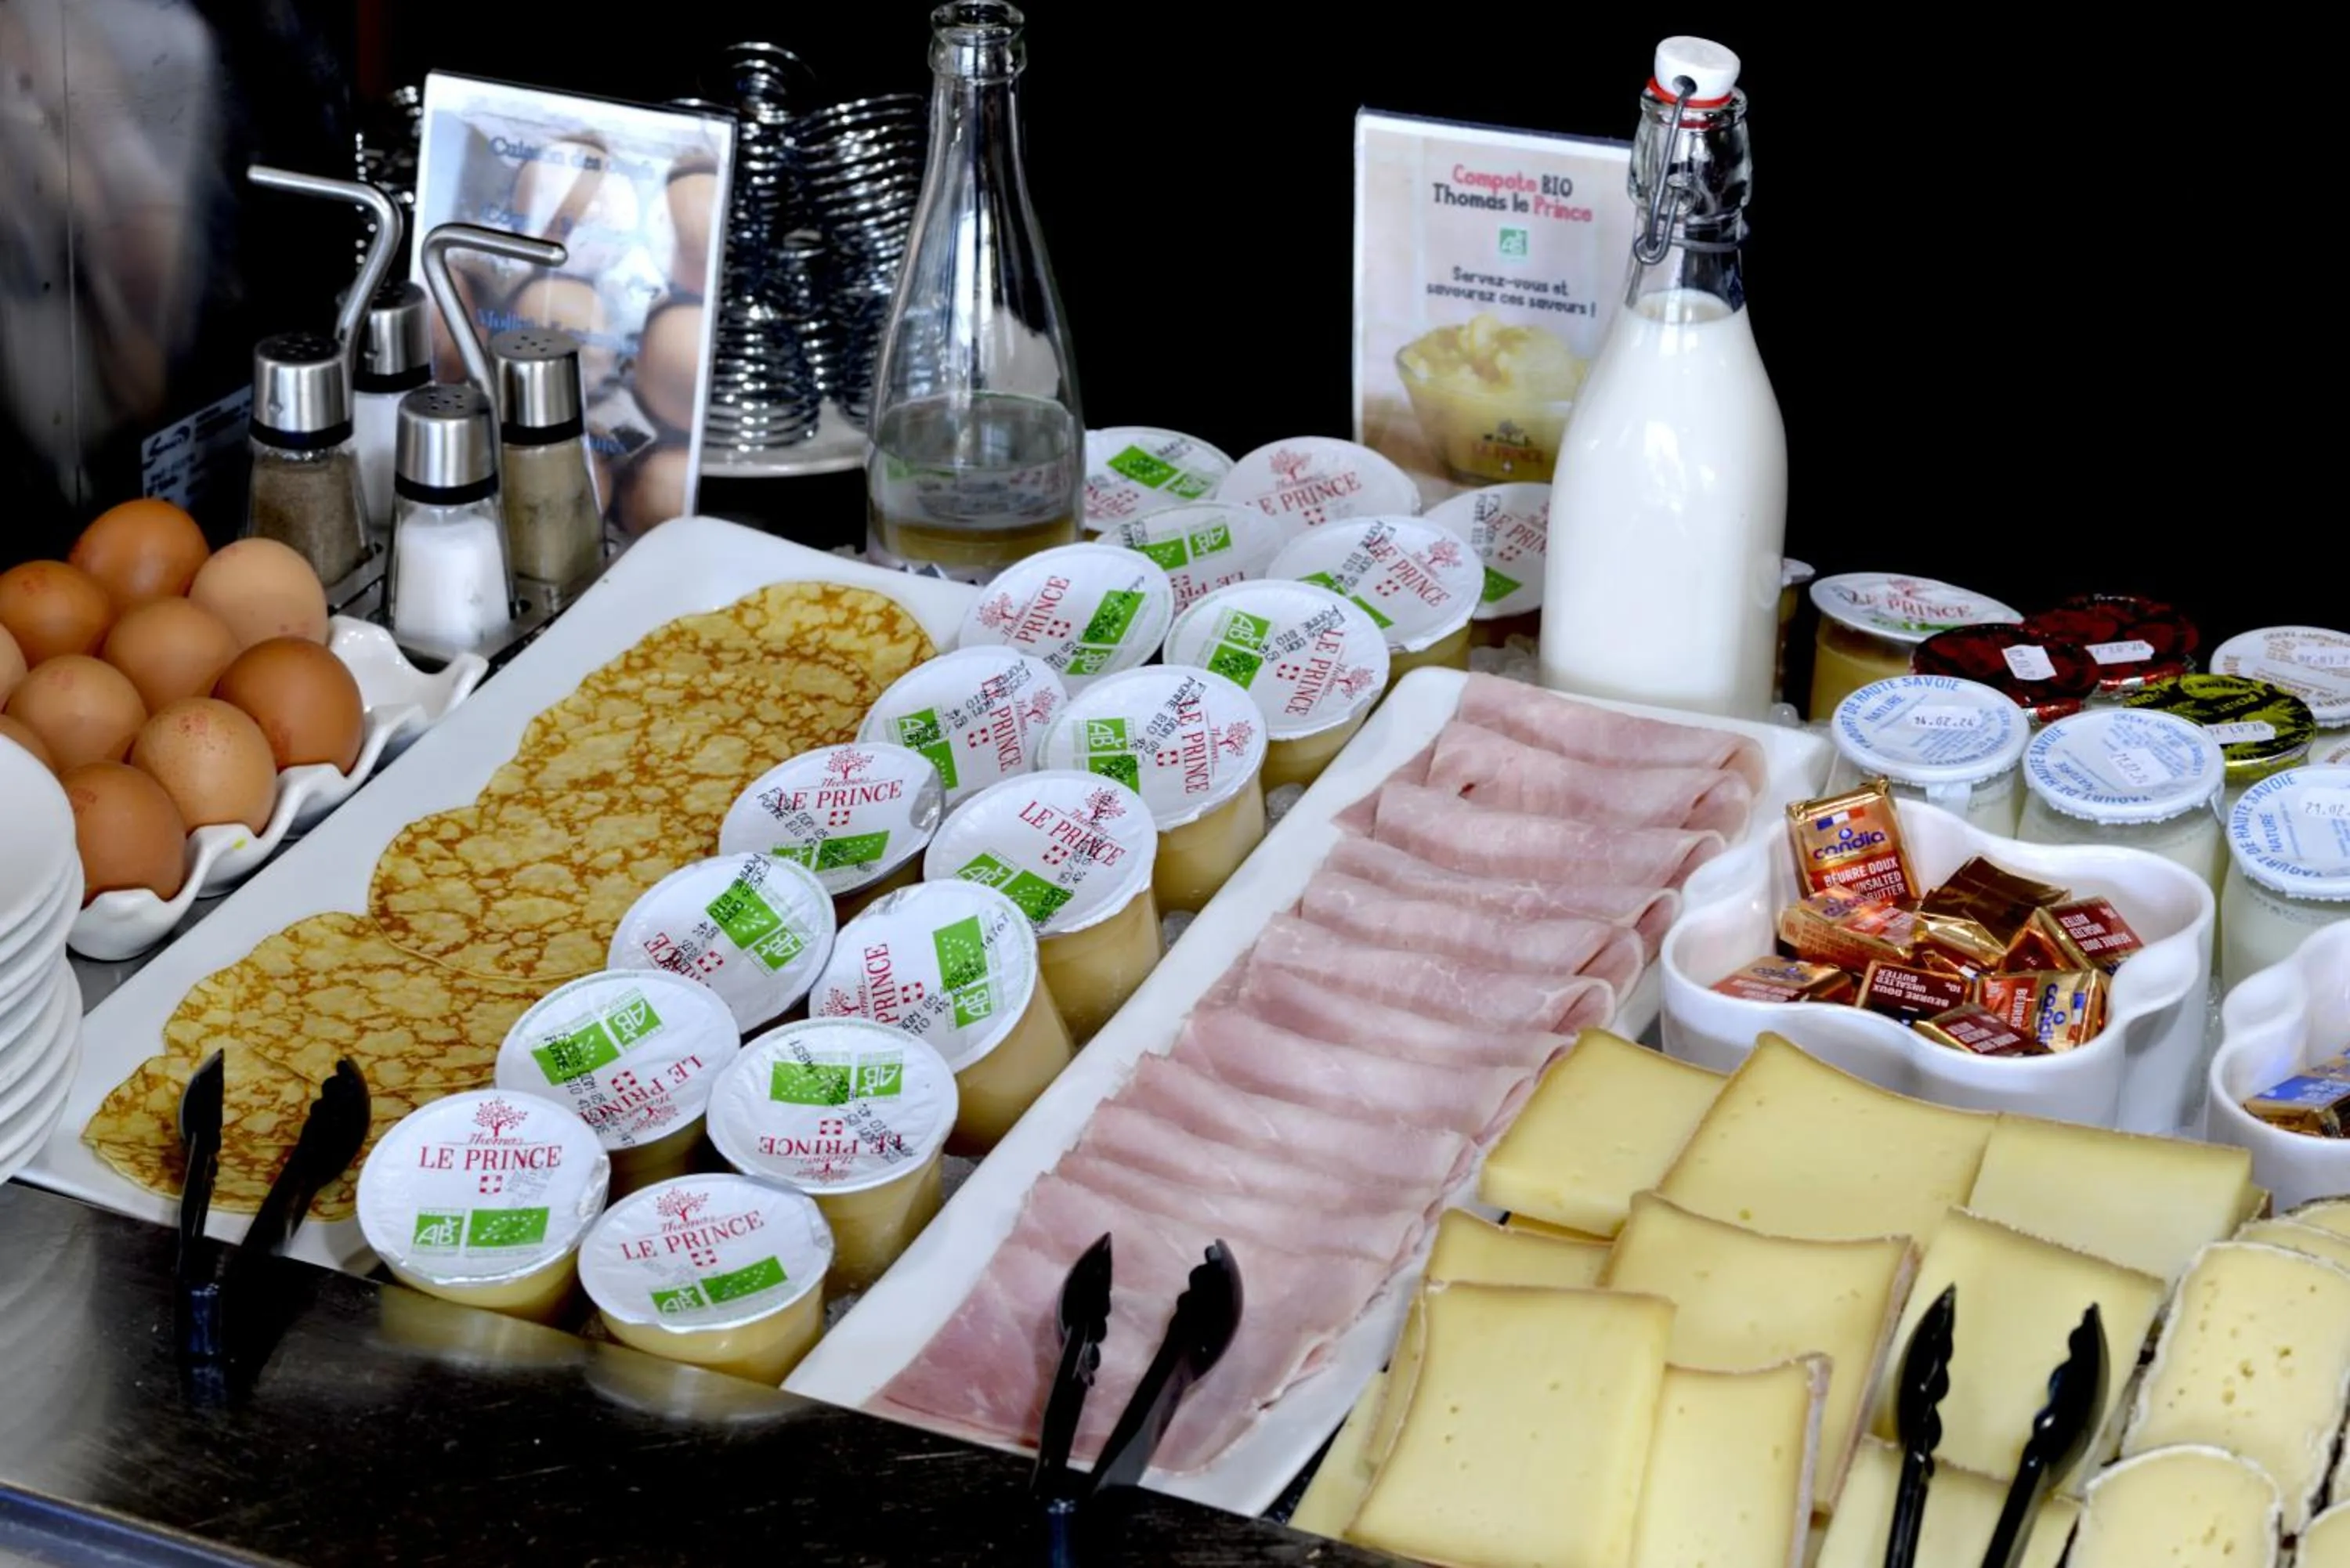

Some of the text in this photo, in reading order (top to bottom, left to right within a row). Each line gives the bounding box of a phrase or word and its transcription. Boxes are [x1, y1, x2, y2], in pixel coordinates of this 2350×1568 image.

[1452, 164, 1573, 197] Compote BIO
[1433, 182, 1593, 222] Thomas le Prince
[1453, 266, 1569, 297] Servez-vous et
[1426, 283, 1496, 302] savourez
[1500, 293, 1524, 306] ces
[1529, 297, 1586, 315] saveurs
[1280, 471, 1362, 511] PRINCE
[1506, 523, 1546, 556] PRIN
[1386, 559, 1452, 608] PRINCE
[1016, 575, 1071, 645] PRINCE
[1887, 598, 1973, 620] PRINCE
[1228, 613, 1256, 641] AB
[1285, 628, 1345, 717] LE PRINCE
[1146, 712, 1169, 735] BIO
[1839, 677, 1961, 749] YAOURT DE HAUTE SAVOIE
[1864, 693, 1906, 723] NATURE
[989, 705, 1021, 773] PRINCE
[1090, 721, 1115, 749] AB
[1180, 731, 1210, 795] PRINCE
[817, 779, 903, 809] PRINCE
[2232, 804, 2253, 840] HAUTE
[2244, 771, 2298, 804] SAVOIE
[1019, 800, 1127, 867] LE PRINCE
[1813, 829, 1886, 860] candia
[2258, 813, 2285, 853] NATURE
[1824, 857, 1899, 887] BEURRE DOUX
[1852, 871, 1902, 894] UNSALTED
[864, 942, 900, 1024] PRINCE
[1875, 976, 1928, 993] UNSALTED
[1878, 968, 1919, 984] BUTTER
[965, 988, 990, 1017] AB
[1872, 983, 1950, 1008] BEURRE DOUX
[613, 1001, 647, 1034] AB
[2038, 982, 2059, 1043] candi
[583, 1054, 703, 1126] LE PRINC
[863, 1064, 900, 1087] AB
[469, 1132, 524, 1146] Thomas
[758, 1136, 859, 1156] PRINCE
[418, 1145, 562, 1171] LE PRINCE
[415, 1219, 457, 1245] AB
[620, 1209, 765, 1261] LE PRINCE
[660, 1215, 716, 1234] Thomas
